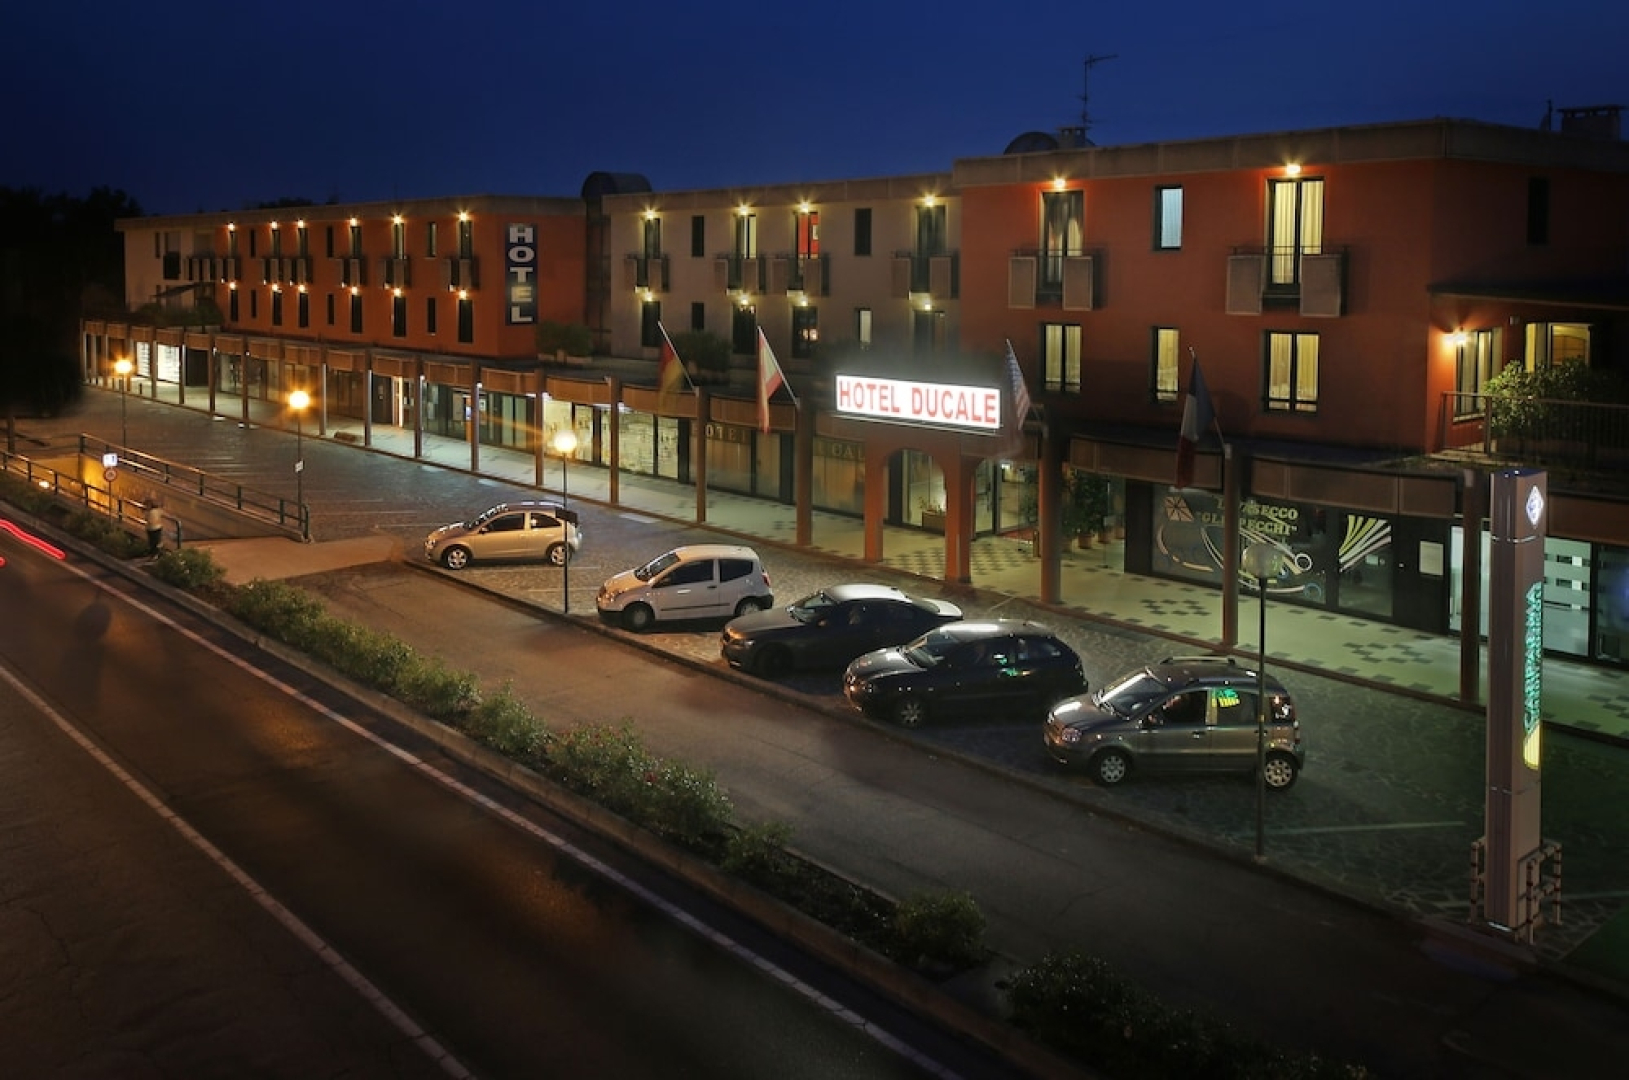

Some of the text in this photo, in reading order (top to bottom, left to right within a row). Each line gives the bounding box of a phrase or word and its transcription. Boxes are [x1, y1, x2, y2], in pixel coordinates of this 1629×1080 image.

[508, 226, 535, 322] HOTEL
[838, 380, 996, 424] HOTEL DUCALE
